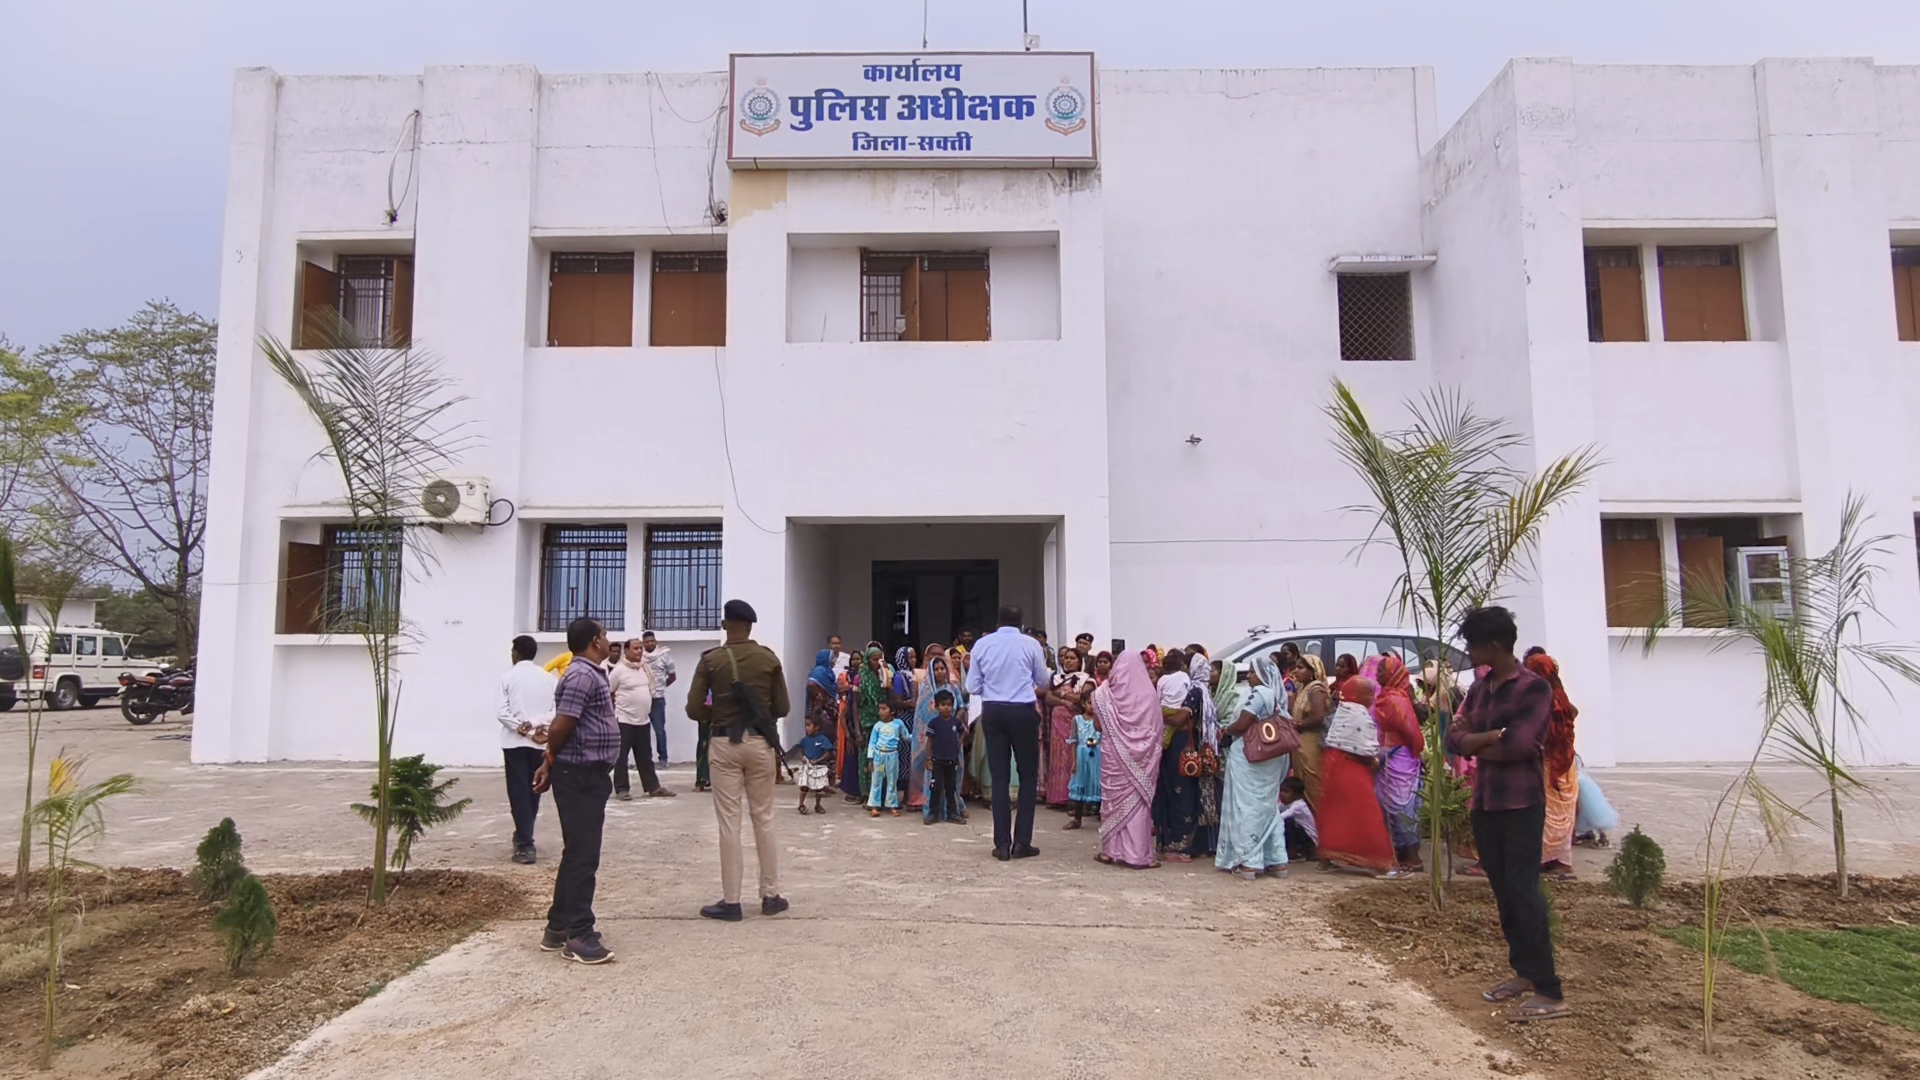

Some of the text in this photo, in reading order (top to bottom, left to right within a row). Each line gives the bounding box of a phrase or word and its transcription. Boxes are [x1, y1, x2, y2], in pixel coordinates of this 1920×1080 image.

[862, 58, 962, 82] कार्यालय
[789, 88, 890, 132] पुलिस
[896, 87, 1037, 121] अधीक्षक
[852, 131, 973, 151] जिला-सक्ती
